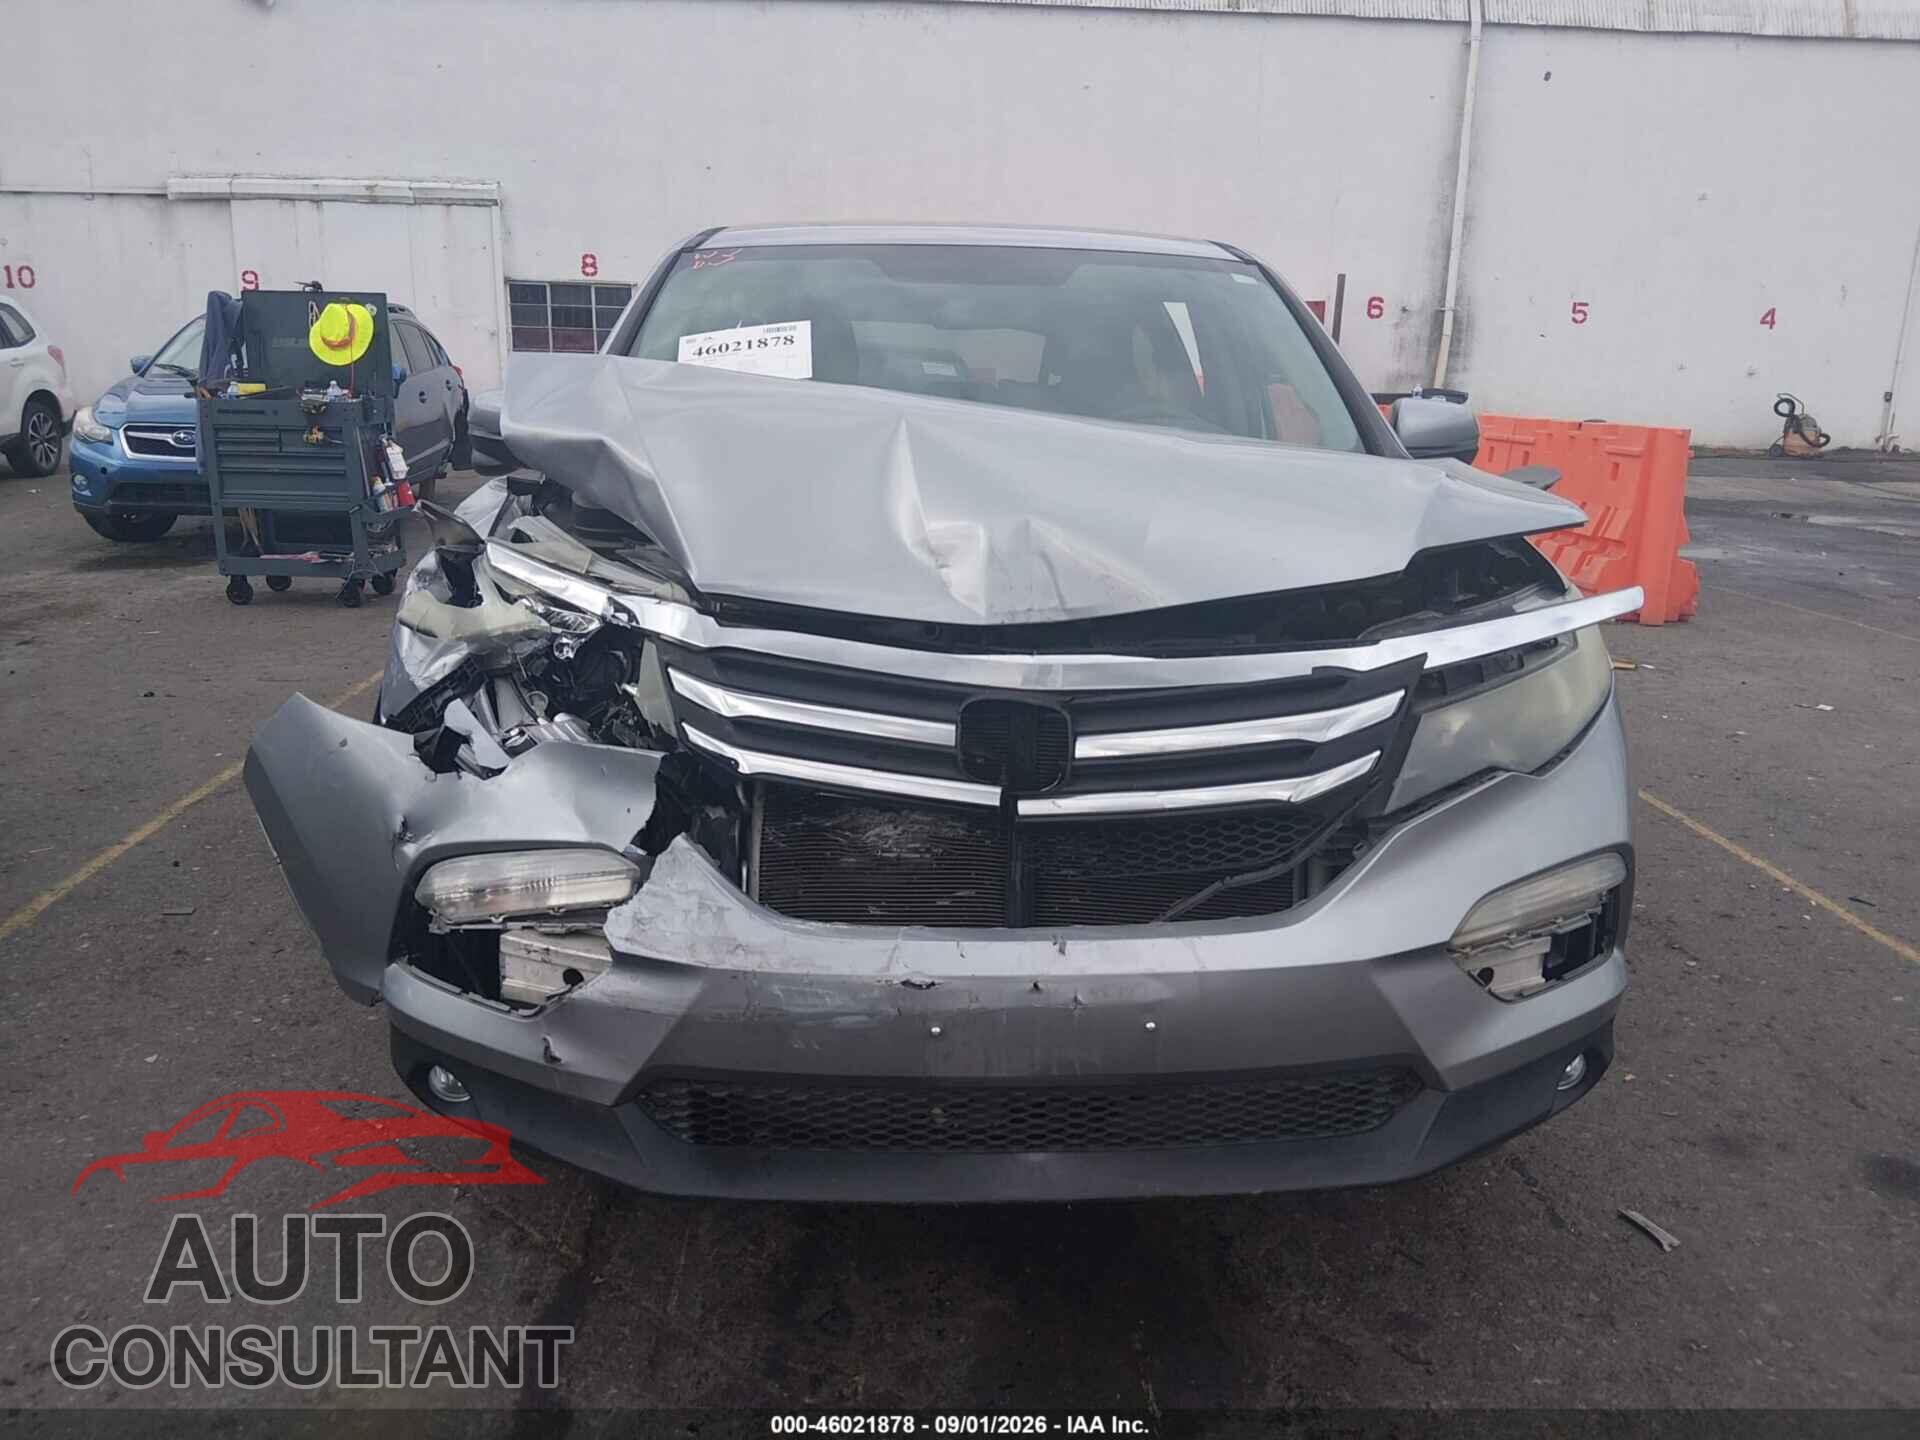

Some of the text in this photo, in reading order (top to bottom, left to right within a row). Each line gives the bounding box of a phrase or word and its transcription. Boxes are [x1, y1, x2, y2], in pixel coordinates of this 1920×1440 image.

[581, 253, 598, 277] 8
[3, 265, 36, 289] 10
[241, 270, 259, 292] 9
[1367, 296, 1384, 319] 6
[1571, 302, 1589, 324] 5
[1759, 307, 1776, 330] 4
[692, 335, 796, 357] 46021878
